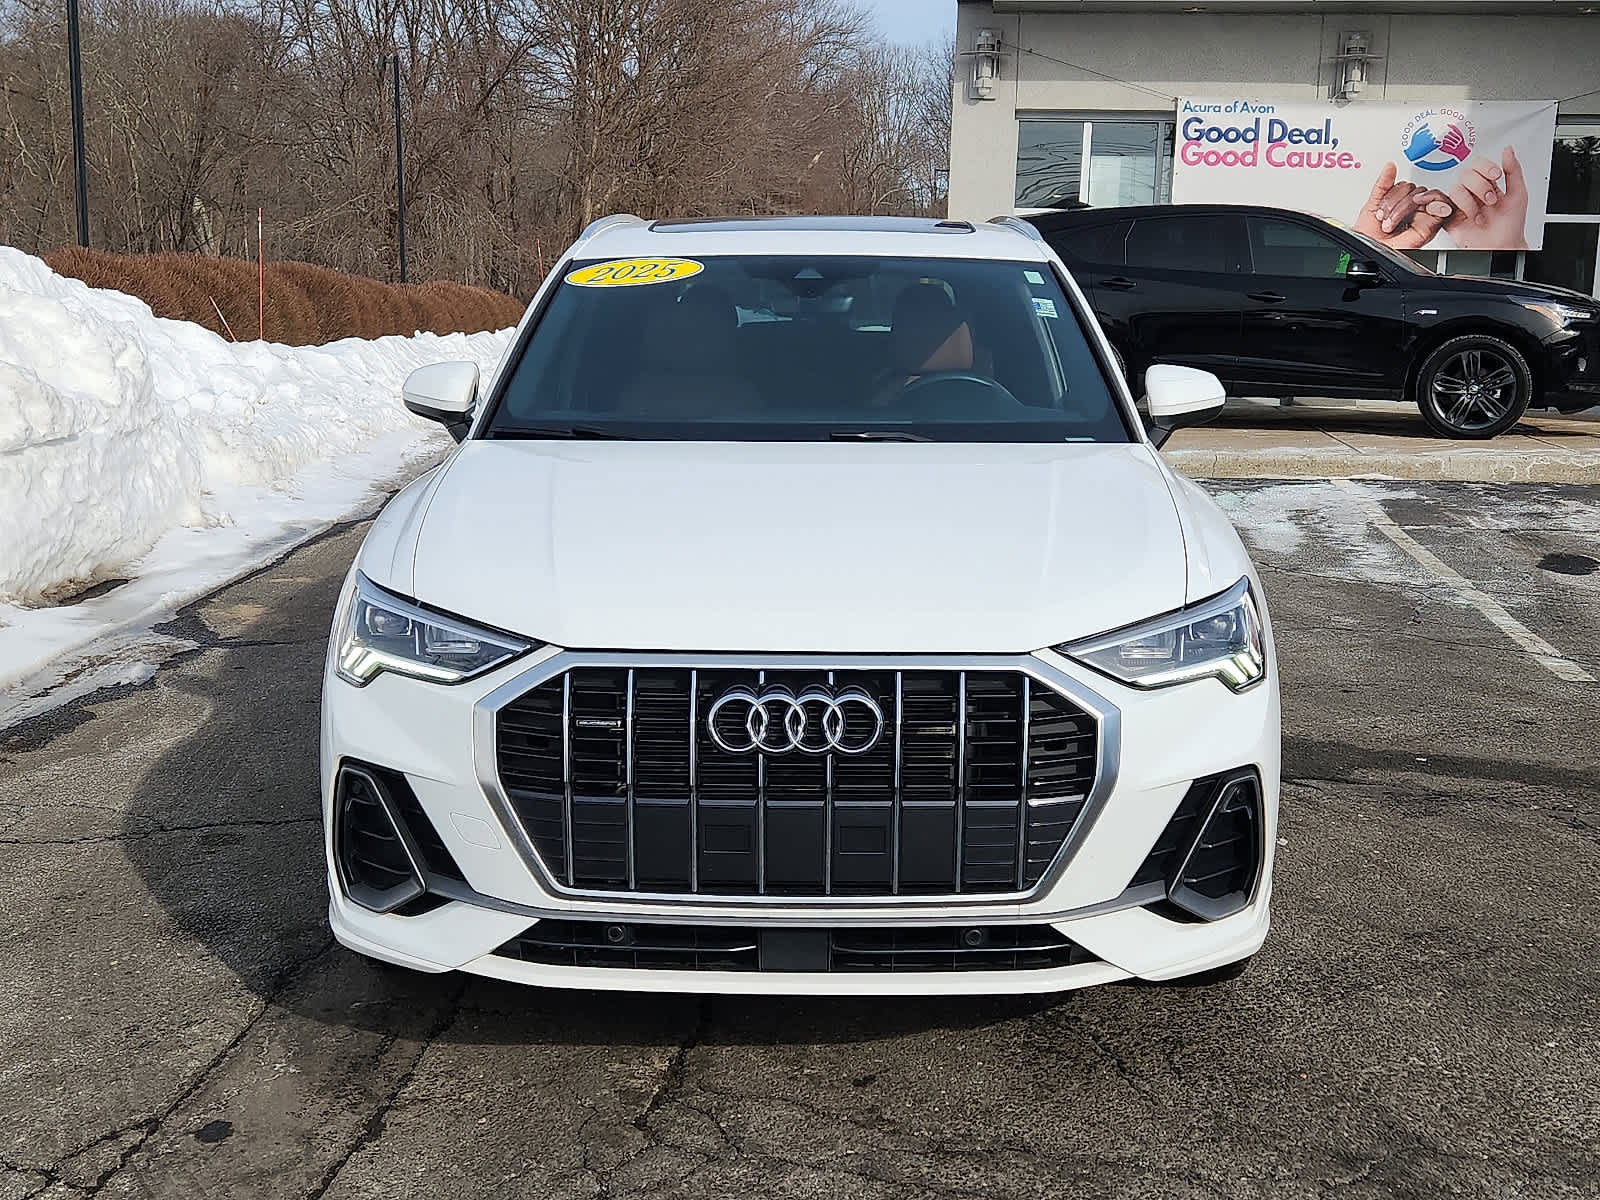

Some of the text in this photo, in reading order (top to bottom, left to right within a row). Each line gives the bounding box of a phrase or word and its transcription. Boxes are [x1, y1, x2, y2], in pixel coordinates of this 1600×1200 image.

[1182, 100, 1275, 114] Acura of Avon
[1182, 116, 1339, 150] Good Deal,
[1401, 121, 1415, 147] GOOD
[1440, 108, 1465, 121] GOOD
[1464, 120, 1476, 148] CAUSE
[1181, 140, 1362, 169] Good Cause.
[586, 262, 683, 283] 2025
